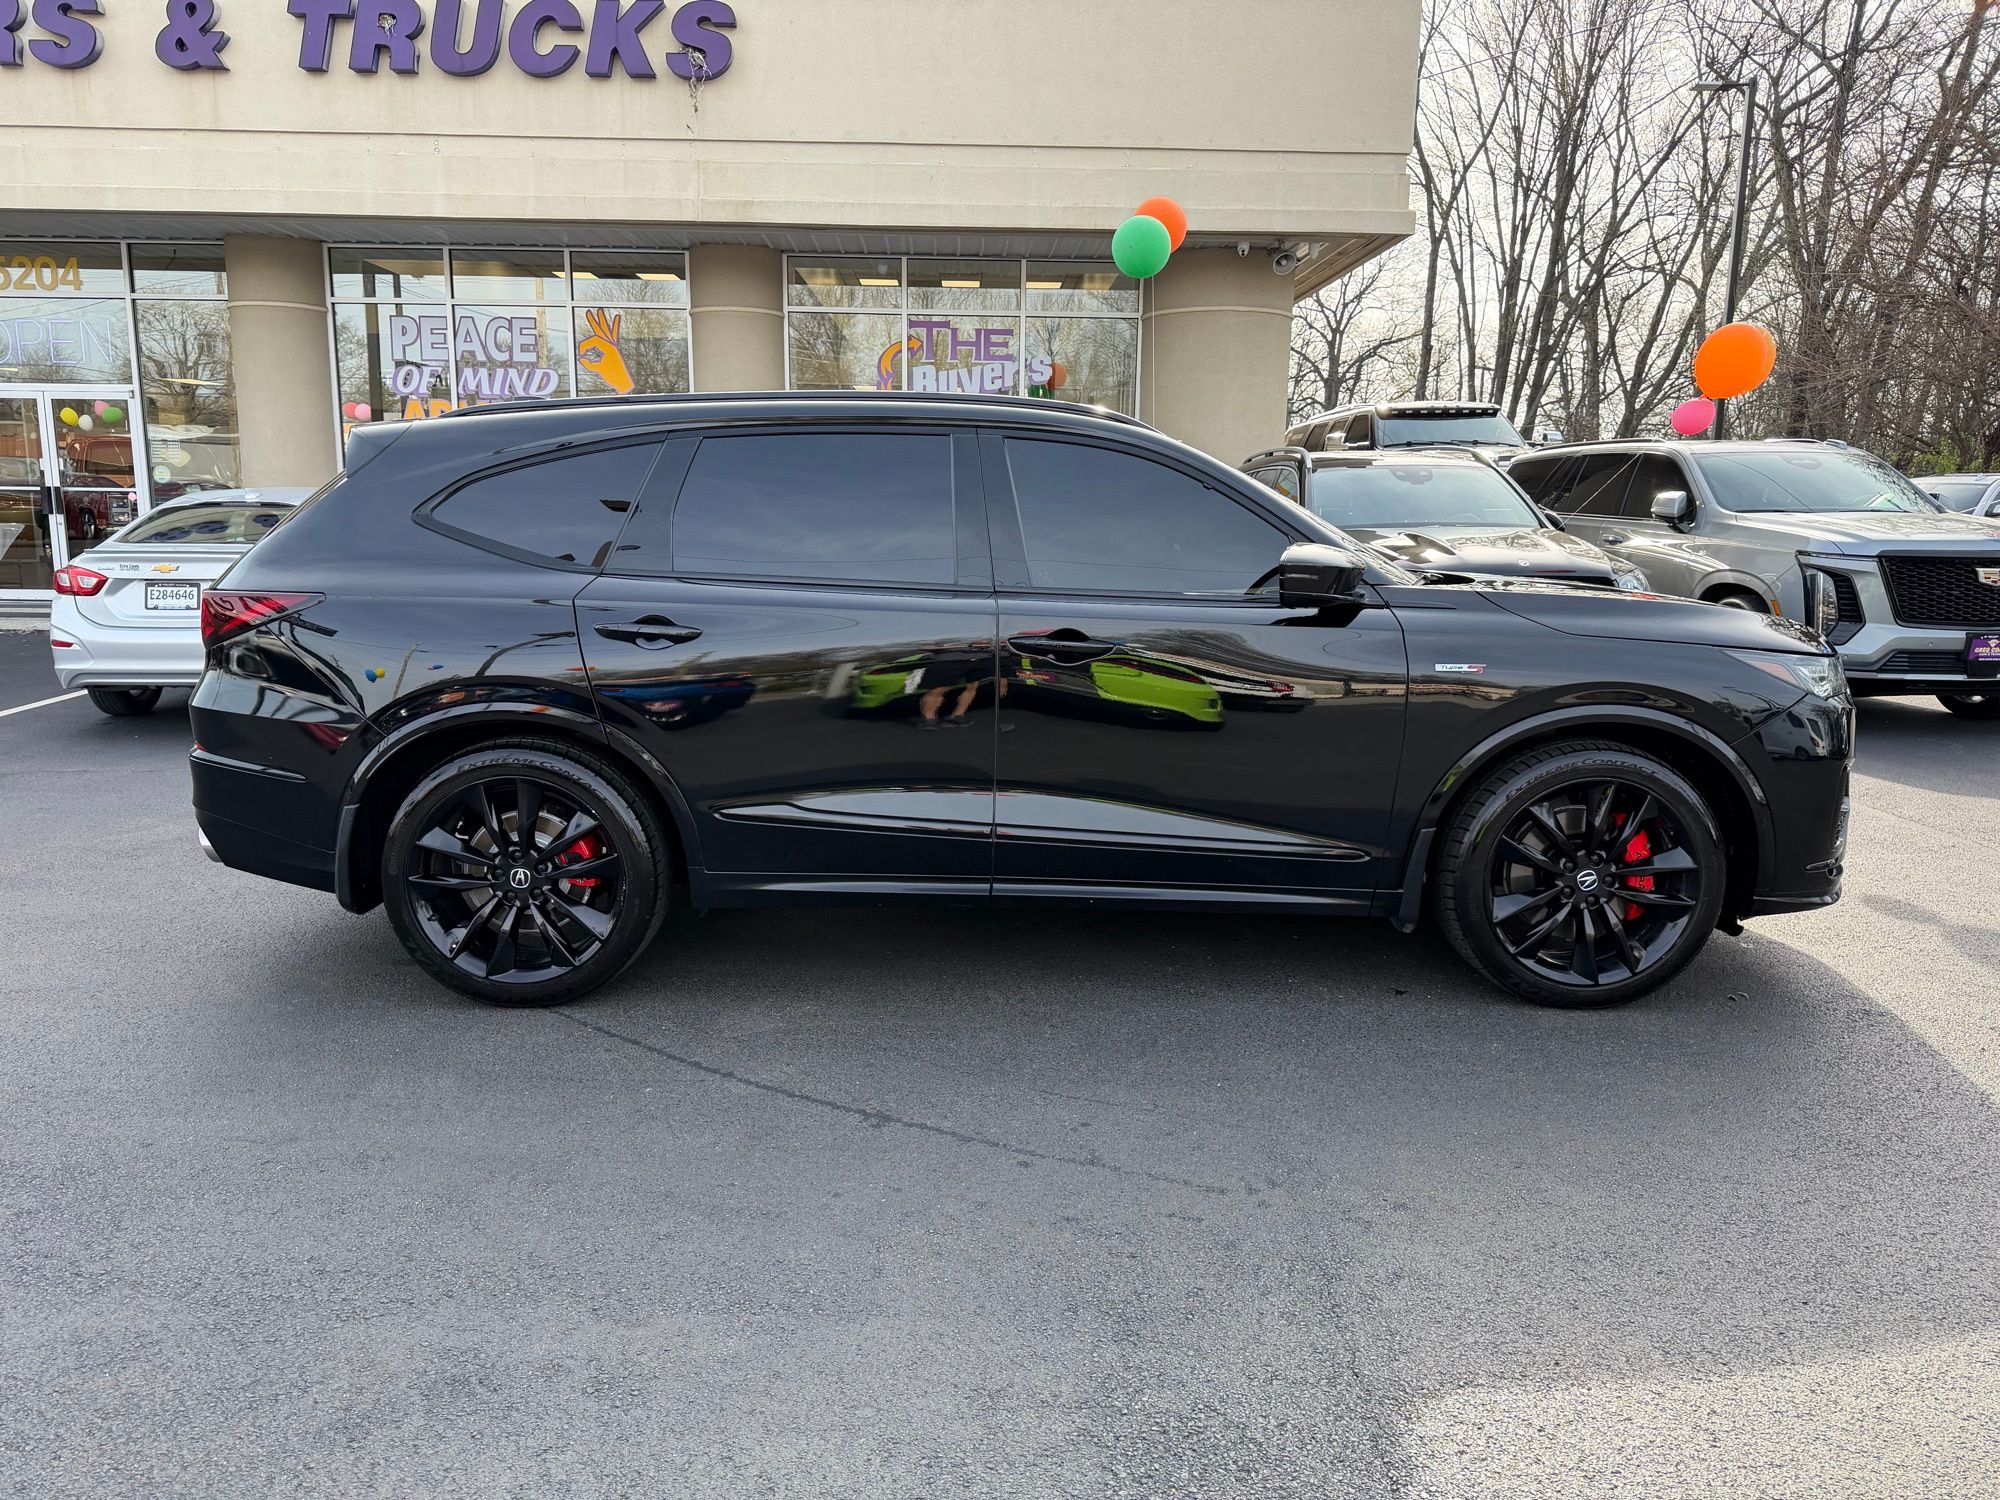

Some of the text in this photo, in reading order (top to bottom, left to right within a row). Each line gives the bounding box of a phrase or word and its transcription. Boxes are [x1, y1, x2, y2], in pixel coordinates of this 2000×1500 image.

[155, 0, 231, 71] &
[288, 0, 737, 80] TRUCKS
[389, 315, 539, 362] PEACE
[908, 320, 1015, 363] THE
[392, 364, 562, 399] OF MIND
[149, 589, 195, 600] E284646
